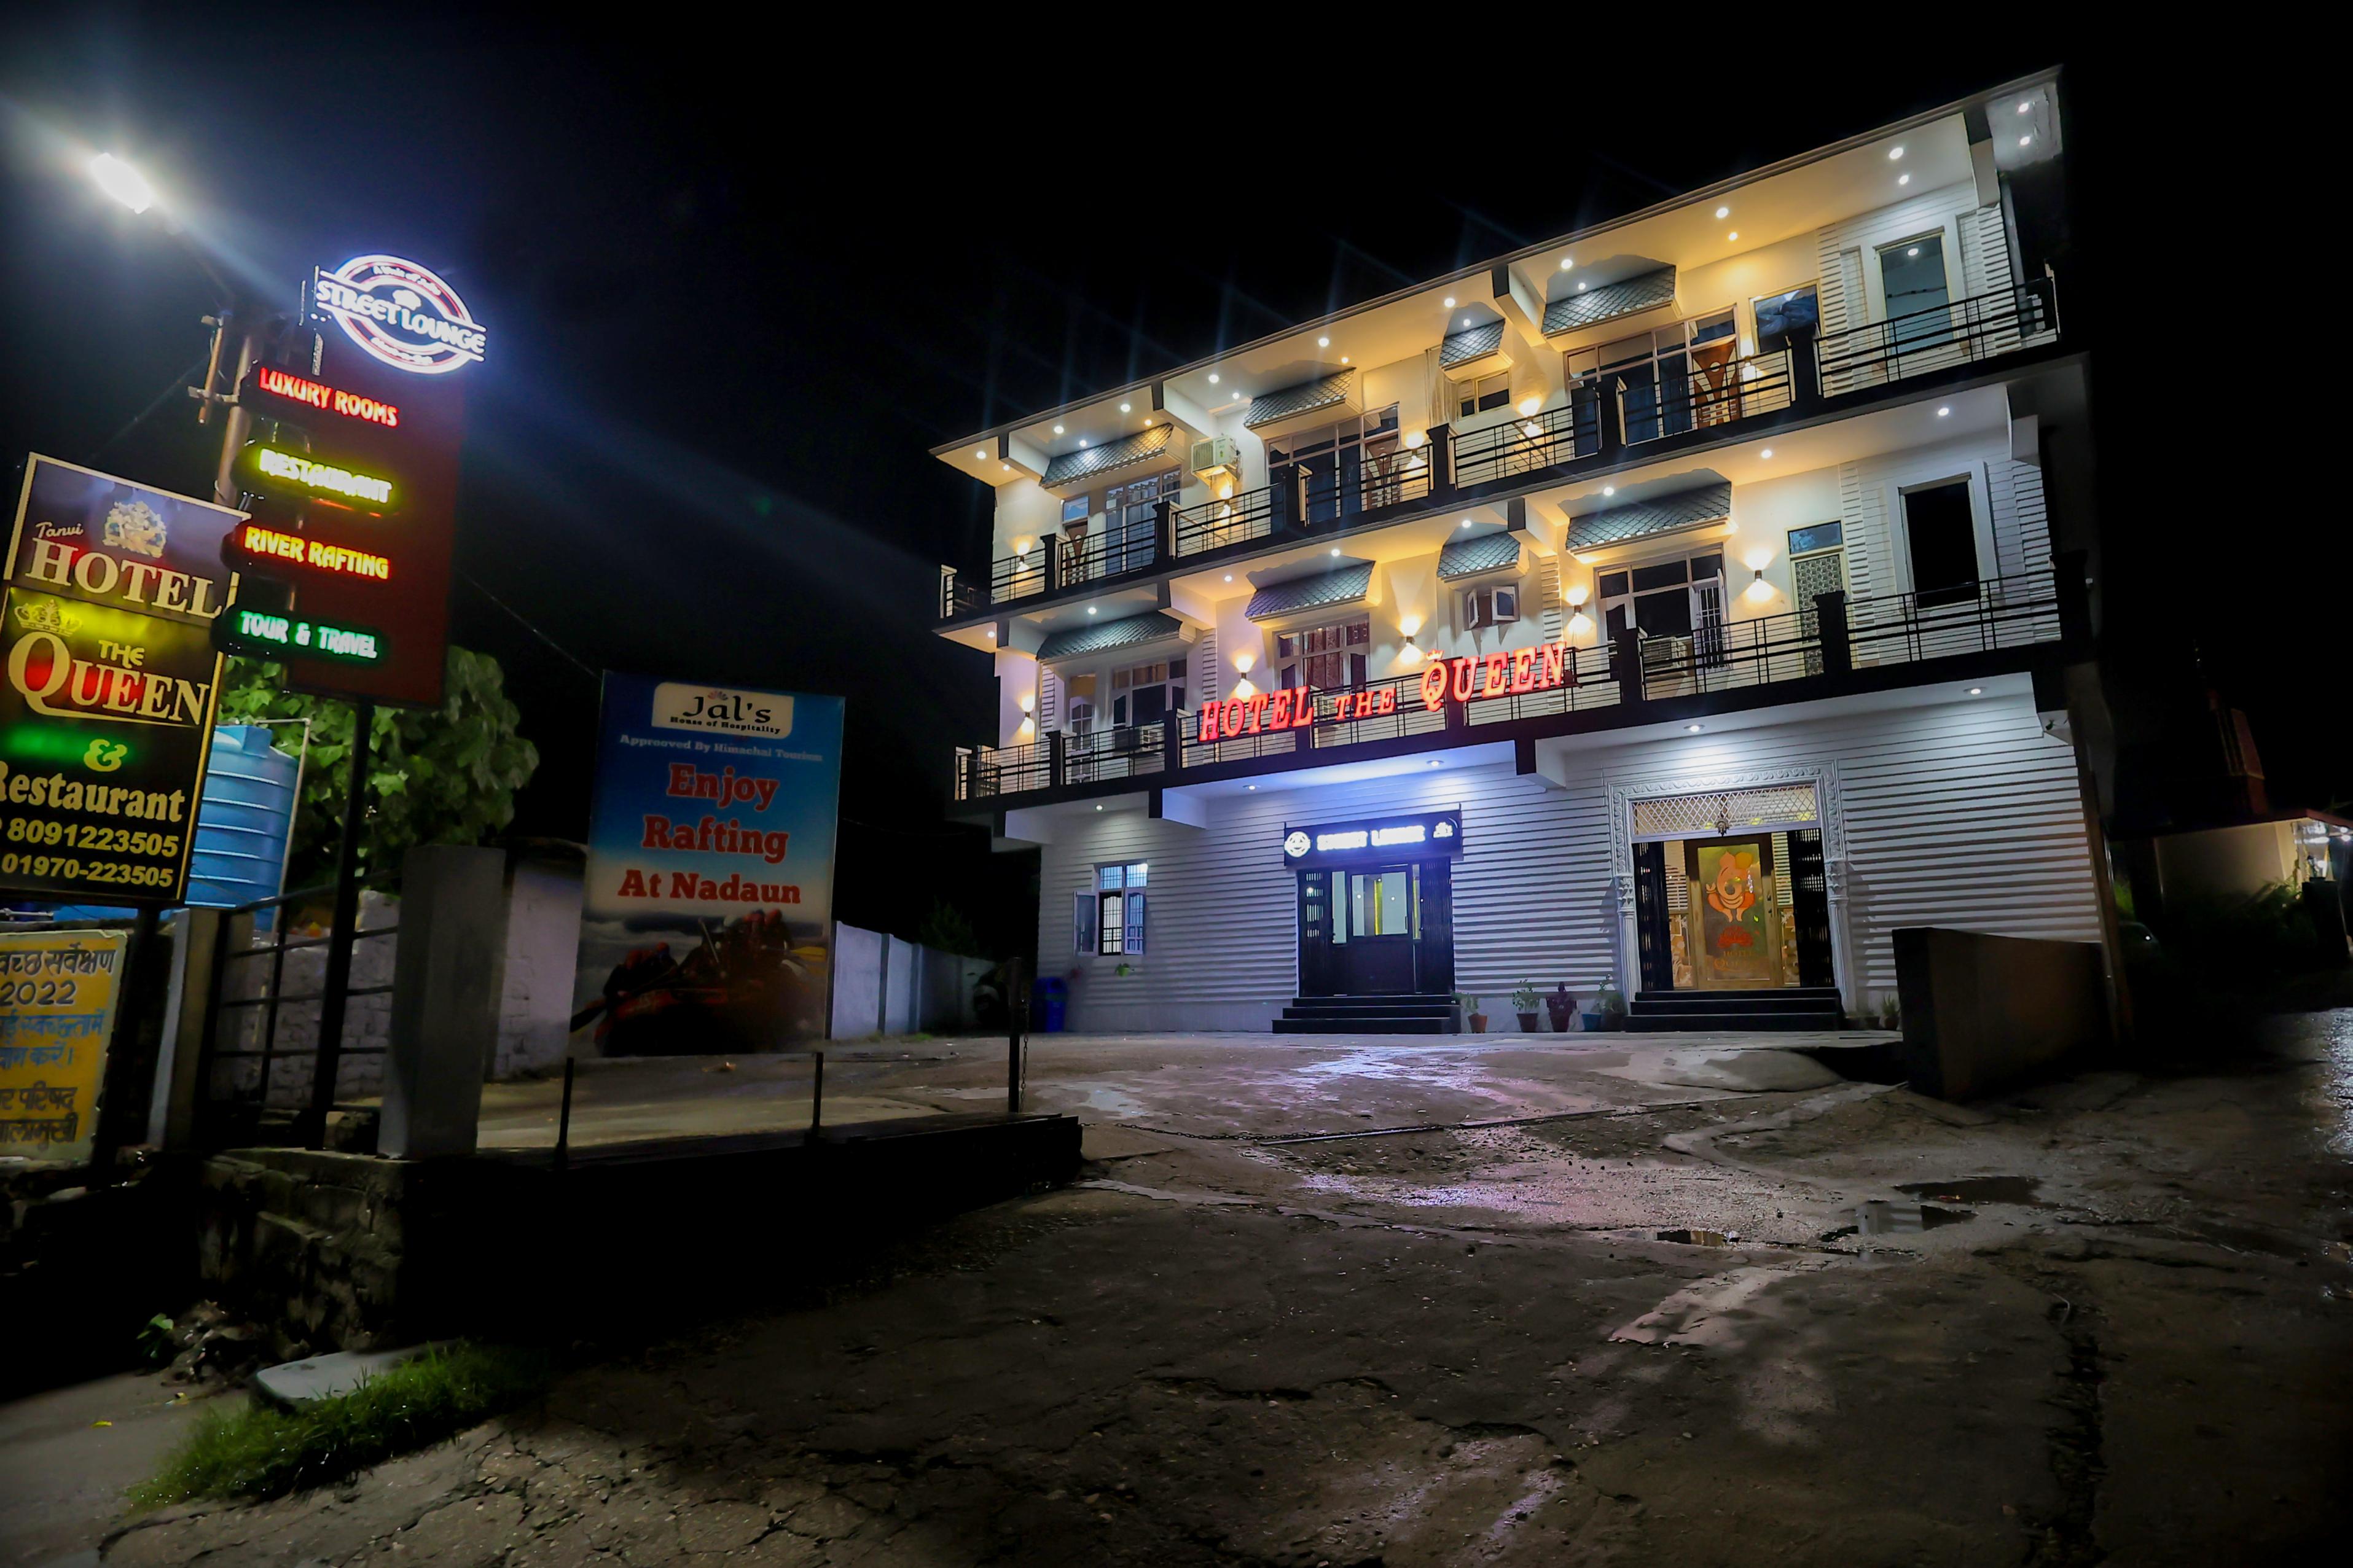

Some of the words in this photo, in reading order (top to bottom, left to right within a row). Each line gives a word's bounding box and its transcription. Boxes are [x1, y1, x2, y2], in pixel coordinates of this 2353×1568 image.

[316, 281, 401, 325] STREET
[401, 308, 487, 354] LOUNGE
[259, 367, 332, 409] LUXURY
[334, 389, 399, 427] ROOMS
[259, 448, 393, 504] RESTAURANT
[35, 521, 84, 540] Tanvi
[245, 526, 305, 563] RIVER
[308, 540, 390, 580] RAFTING
[25, 536, 224, 620] HOTEL
[98, 639, 144, 668] THE
[241, 611, 288, 645] TOUR
[295, 622, 311, 647] &
[319, 626, 378, 659] TRAVEL
[7, 631, 209, 729] QUEEN
[1199, 685, 1315, 742] HOTEL
[1334, 687, 1396, 721] THE
[1420, 641, 1567, 712] QUEEN
[683, 695, 771, 724] Jal's
[721, 722, 780, 735] Hospitality
[83, 739, 128, 772] &
[694, 741, 711, 754] By
[713, 742, 772, 757] Himachal
[667, 763, 779, 811] Enjoy
[6, 817, 180, 858] 8091223505
[642, 814, 788, 864] Rafting
[1, 853, 174, 887] 01970-223505
[617, 869, 661, 898] At
[670, 872, 801, 905] Nadaun
[0, 980, 76, 1006] 2022
